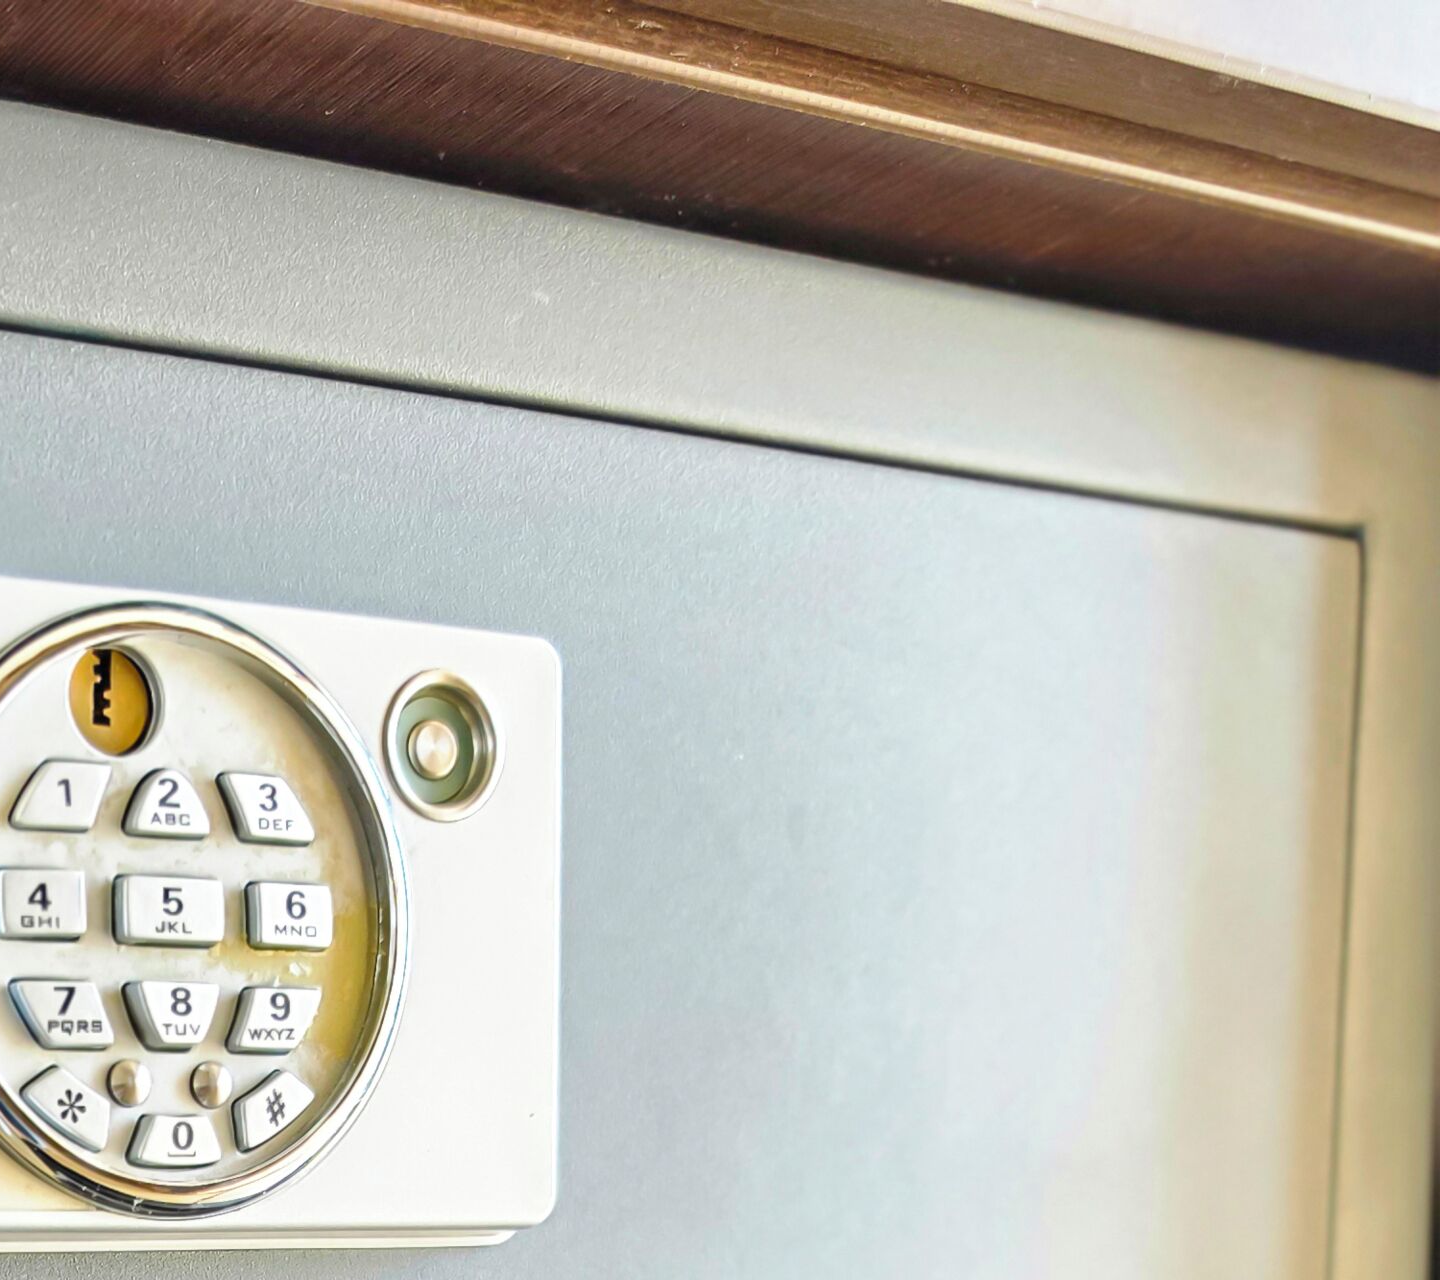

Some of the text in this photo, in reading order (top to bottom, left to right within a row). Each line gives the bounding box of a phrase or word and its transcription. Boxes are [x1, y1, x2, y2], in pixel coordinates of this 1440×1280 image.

[57, 778, 72, 807] 1
[158, 778, 181, 808] 2
[259, 783, 278, 812] 3
[151, 813, 191, 827] ABC
[258, 817, 294, 831] DEF
[27, 882, 52, 911] 4
[162, 886, 184, 916] 5
[285, 890, 307, 920] 6
[20, 915, 60, 929] GHI
[155, 920, 193, 934] JKL
[274, 924, 317, 938] MNO
[53, 986, 76, 1016] 7
[170, 986, 193, 1017] 8
[269, 992, 291, 1022] 9
[46, 1019, 103, 1035] PQRS
[163, 1022, 201, 1037] TUV
[248, 1027, 297, 1042] WXYZ
[172, 1121, 194, 1151] 0
